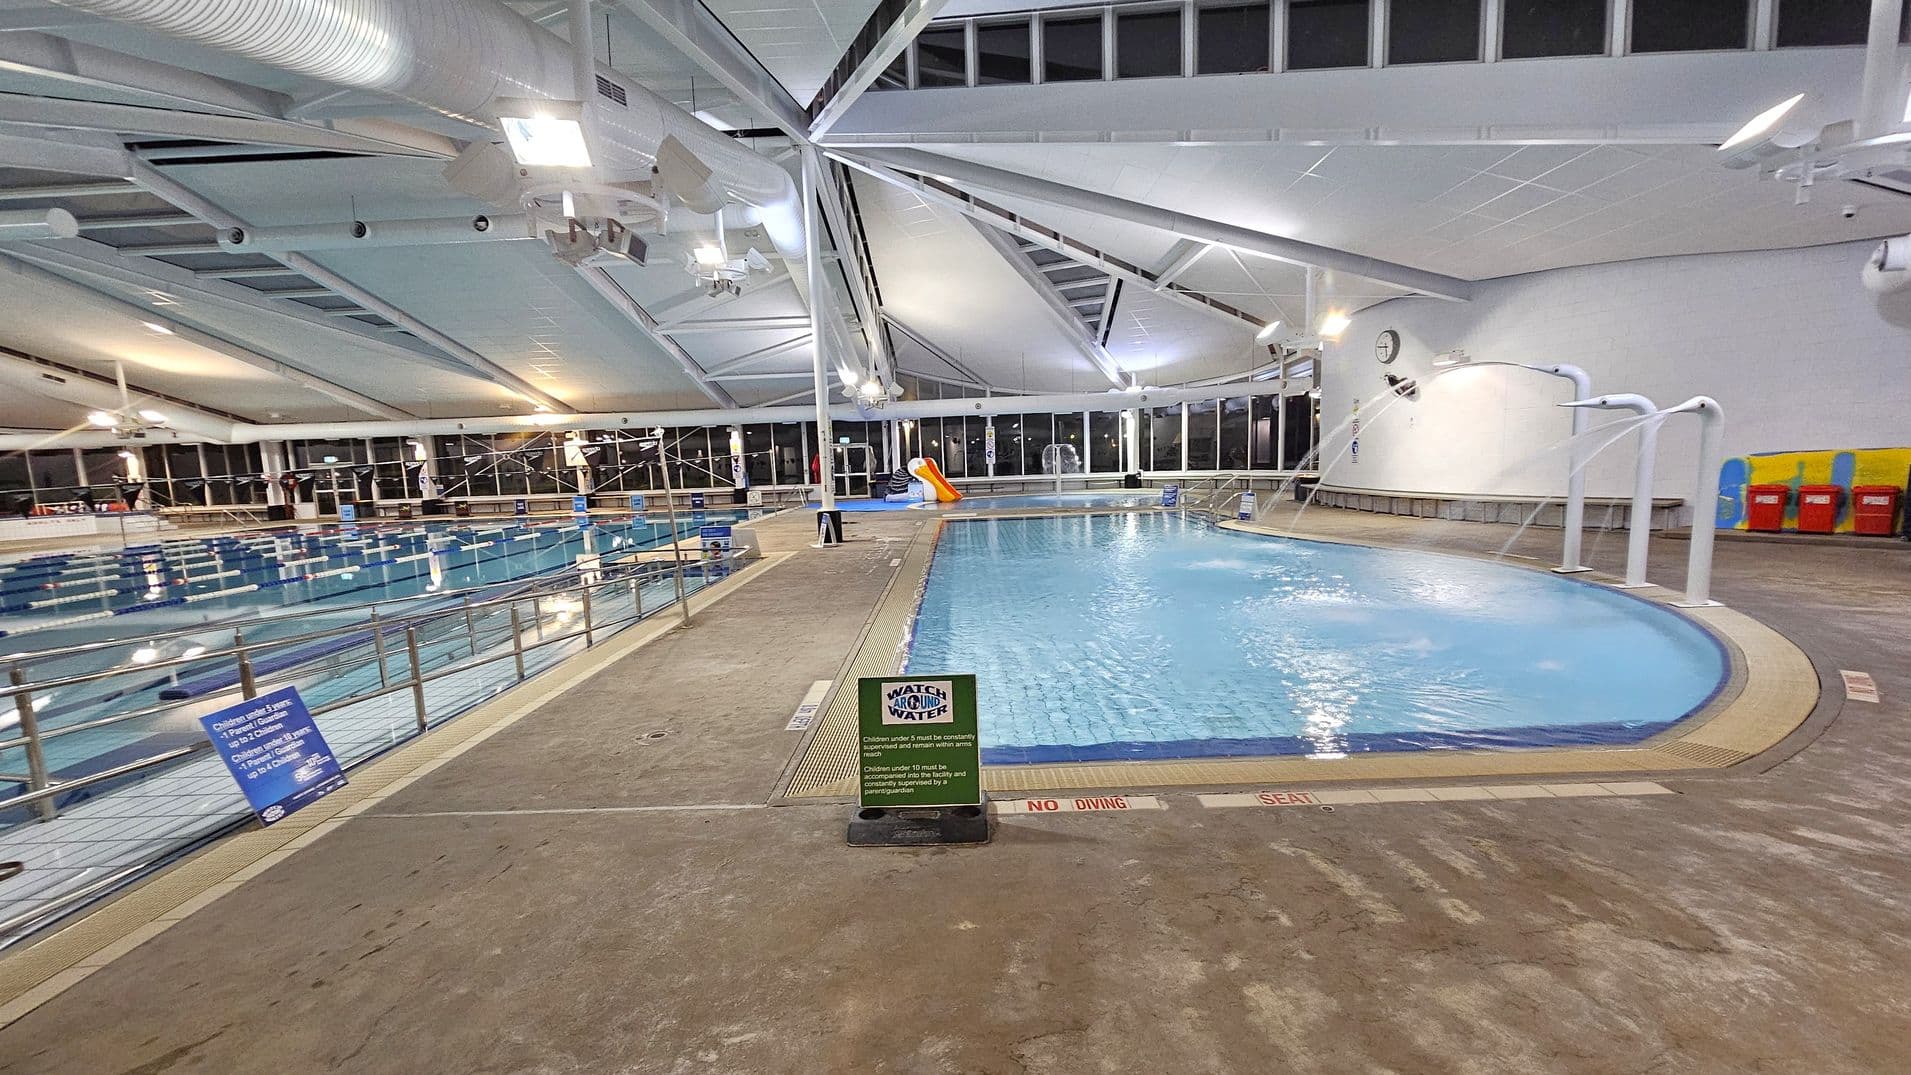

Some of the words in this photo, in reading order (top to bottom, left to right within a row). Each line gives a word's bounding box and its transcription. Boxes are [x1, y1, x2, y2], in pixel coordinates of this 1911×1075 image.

[887, 684, 947, 701] WATCH
[894, 694, 941, 710] AROUND
[212, 716, 246, 731] Children
[245, 708, 266, 719] under
[228, 722, 254, 736] Parent
[257, 710, 288, 725] Guardian
[888, 704, 948, 721] WATER
[228, 740, 240, 748] up
[254, 723, 284, 737] Children
[231, 746, 264, 762] Children
[263, 737, 284, 750] under
[246, 753, 272, 767] Parent
[275, 739, 304, 755] Guardian
[247, 771, 258, 779] up
[272, 752, 301, 767] Children
[1027, 800, 1059, 811] NO
[1073, 798, 1127, 810] DIVING
[1259, 793, 1313, 806] SEAT
